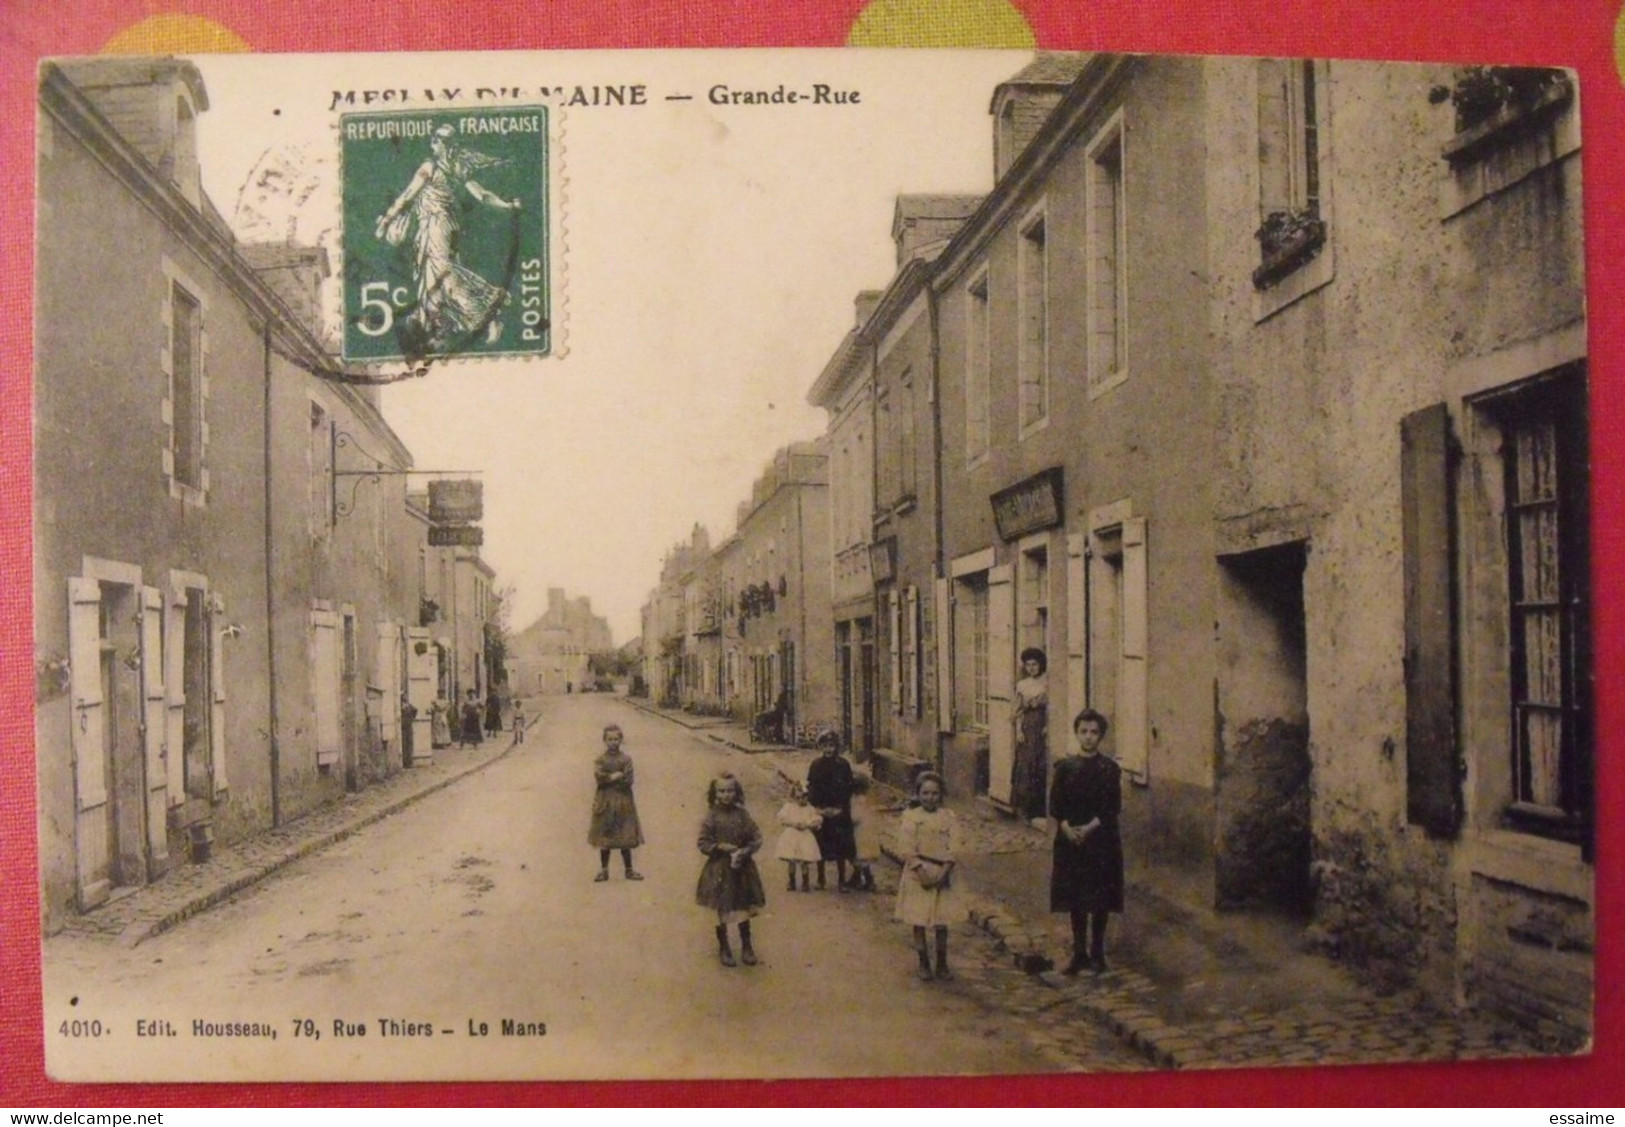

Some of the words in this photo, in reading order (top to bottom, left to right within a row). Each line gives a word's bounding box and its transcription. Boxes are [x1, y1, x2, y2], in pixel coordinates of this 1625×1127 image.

[708, 84, 862, 105] Grande-Rue
[459, 115, 540, 135] FRANÇAISE
[521, 257, 541, 341] POSTES
[136, 1019, 177, 1037] Edit.
[192, 1019, 277, 1040] Housseau,
[292, 1019, 320, 1039] 79,
[333, 1019, 366, 1037] Rue
[378, 1018, 433, 1037] Thiers
[468, 1018, 489, 1036] Le
[501, 1018, 547, 1036] Mans
